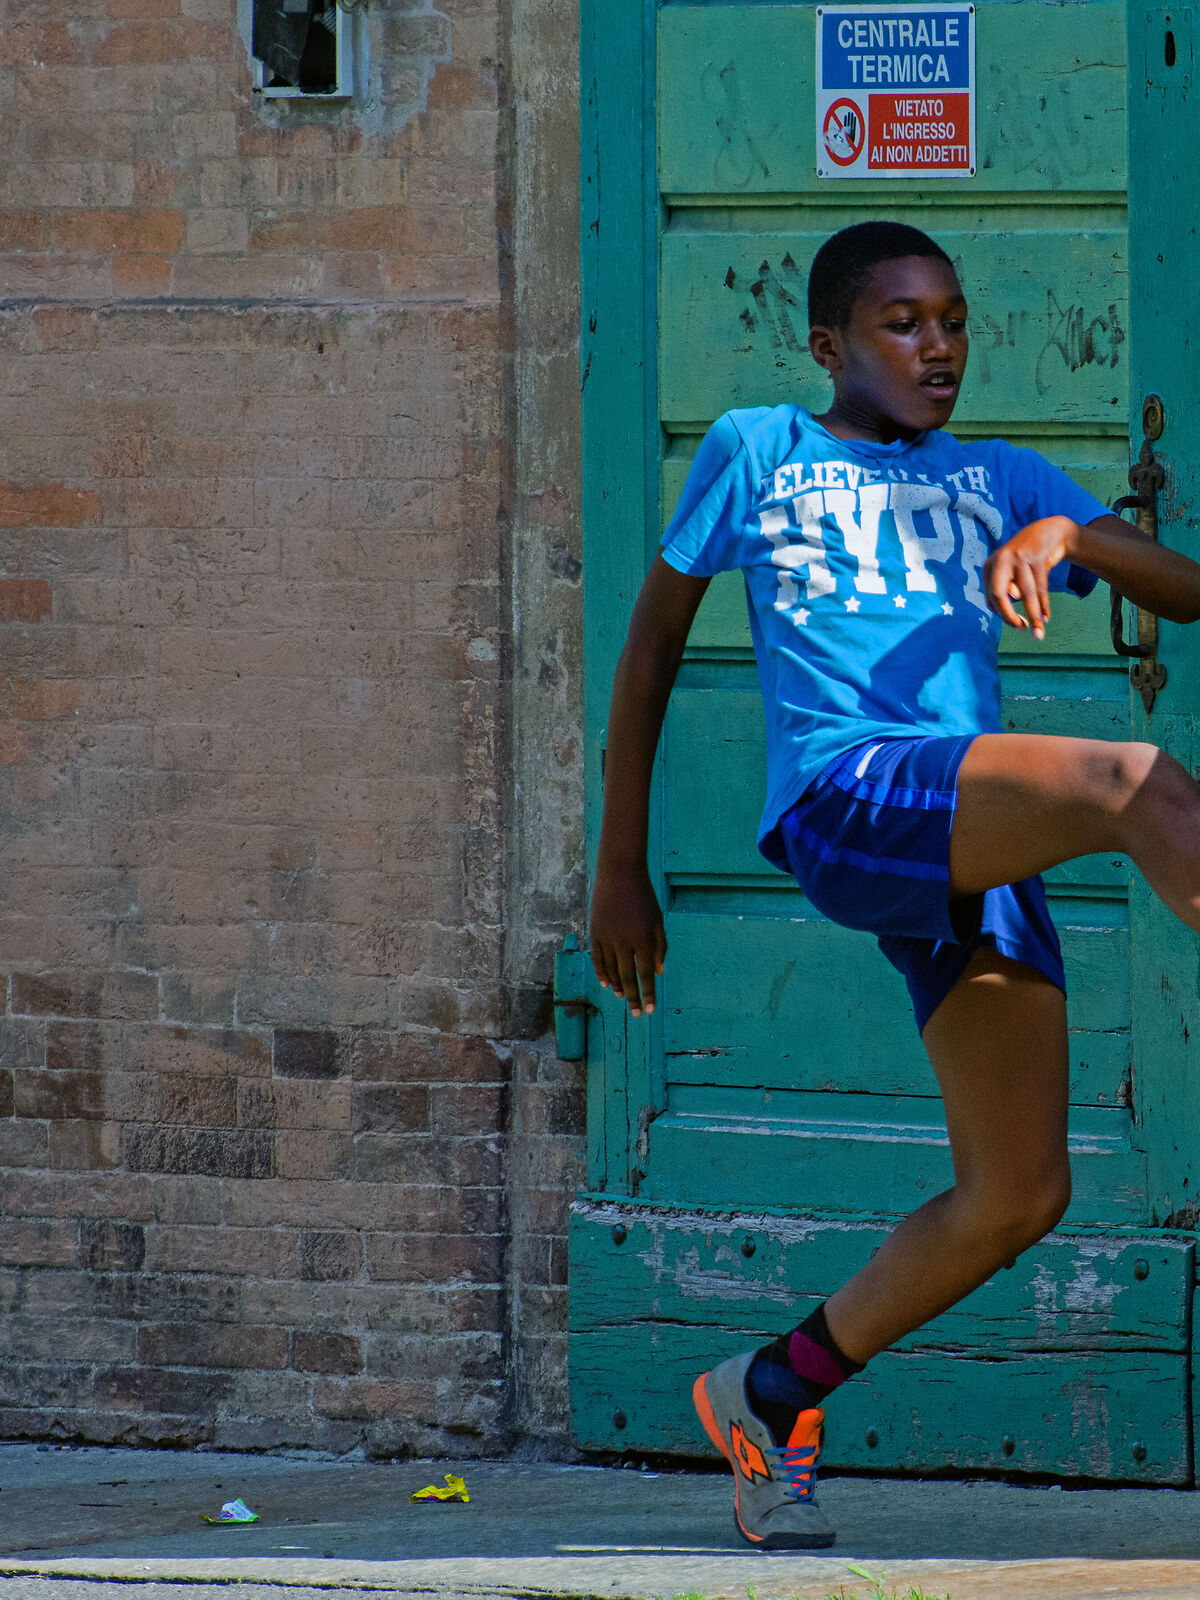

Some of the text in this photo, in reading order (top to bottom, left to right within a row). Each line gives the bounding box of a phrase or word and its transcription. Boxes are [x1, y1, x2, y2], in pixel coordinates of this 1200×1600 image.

[837, 18, 960, 49] CENTRALE
[847, 54, 950, 83] TERMICA
[894, 99, 944, 117] VIETATO
[883, 122, 956, 140] L'INGRESSO
[870, 145, 967, 163] AI NON ADDETTI
[945, 466, 994, 502] TH
